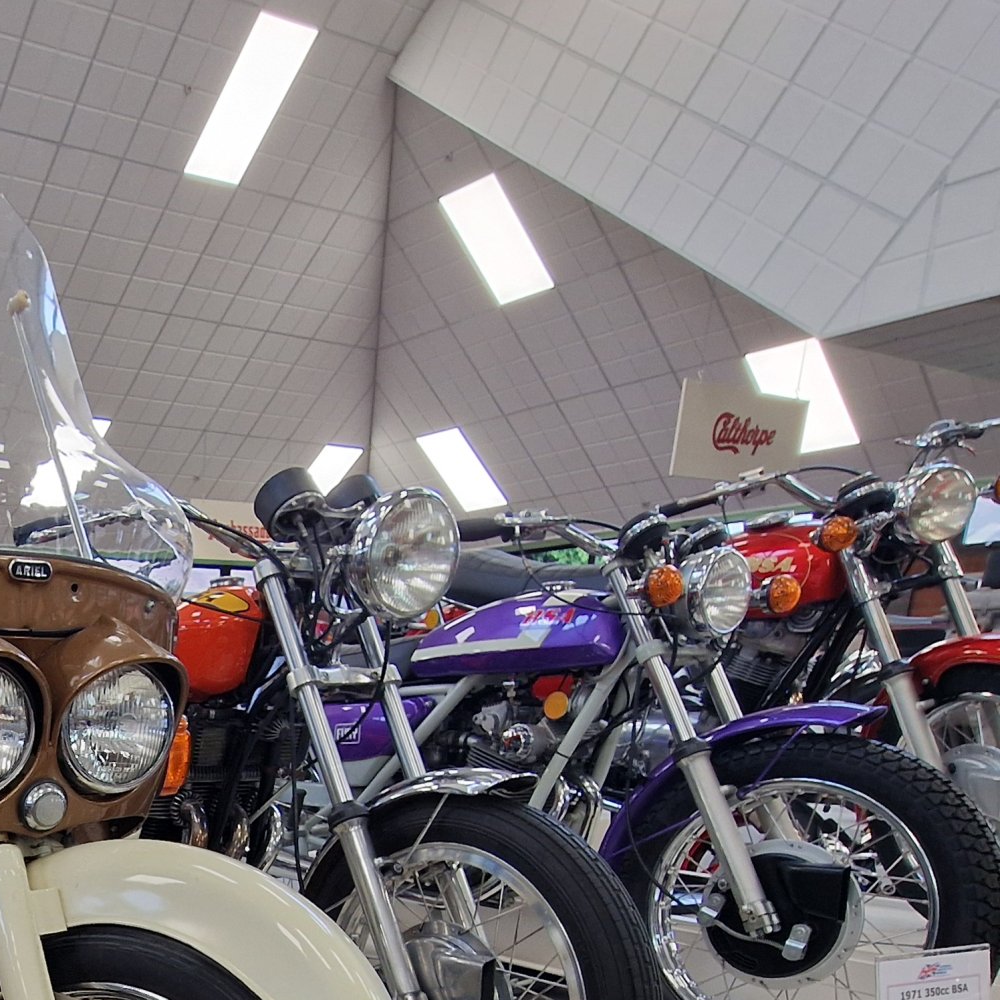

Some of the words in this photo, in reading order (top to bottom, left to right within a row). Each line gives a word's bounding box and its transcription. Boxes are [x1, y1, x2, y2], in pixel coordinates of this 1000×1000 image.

[712, 412, 776, 456] Calthorpe
[15, 565, 48, 577] ARIEL
[901, 989, 922, 1000] 1971
[925, 987, 950, 998] 350cc
[951, 984, 968, 994] BSA
